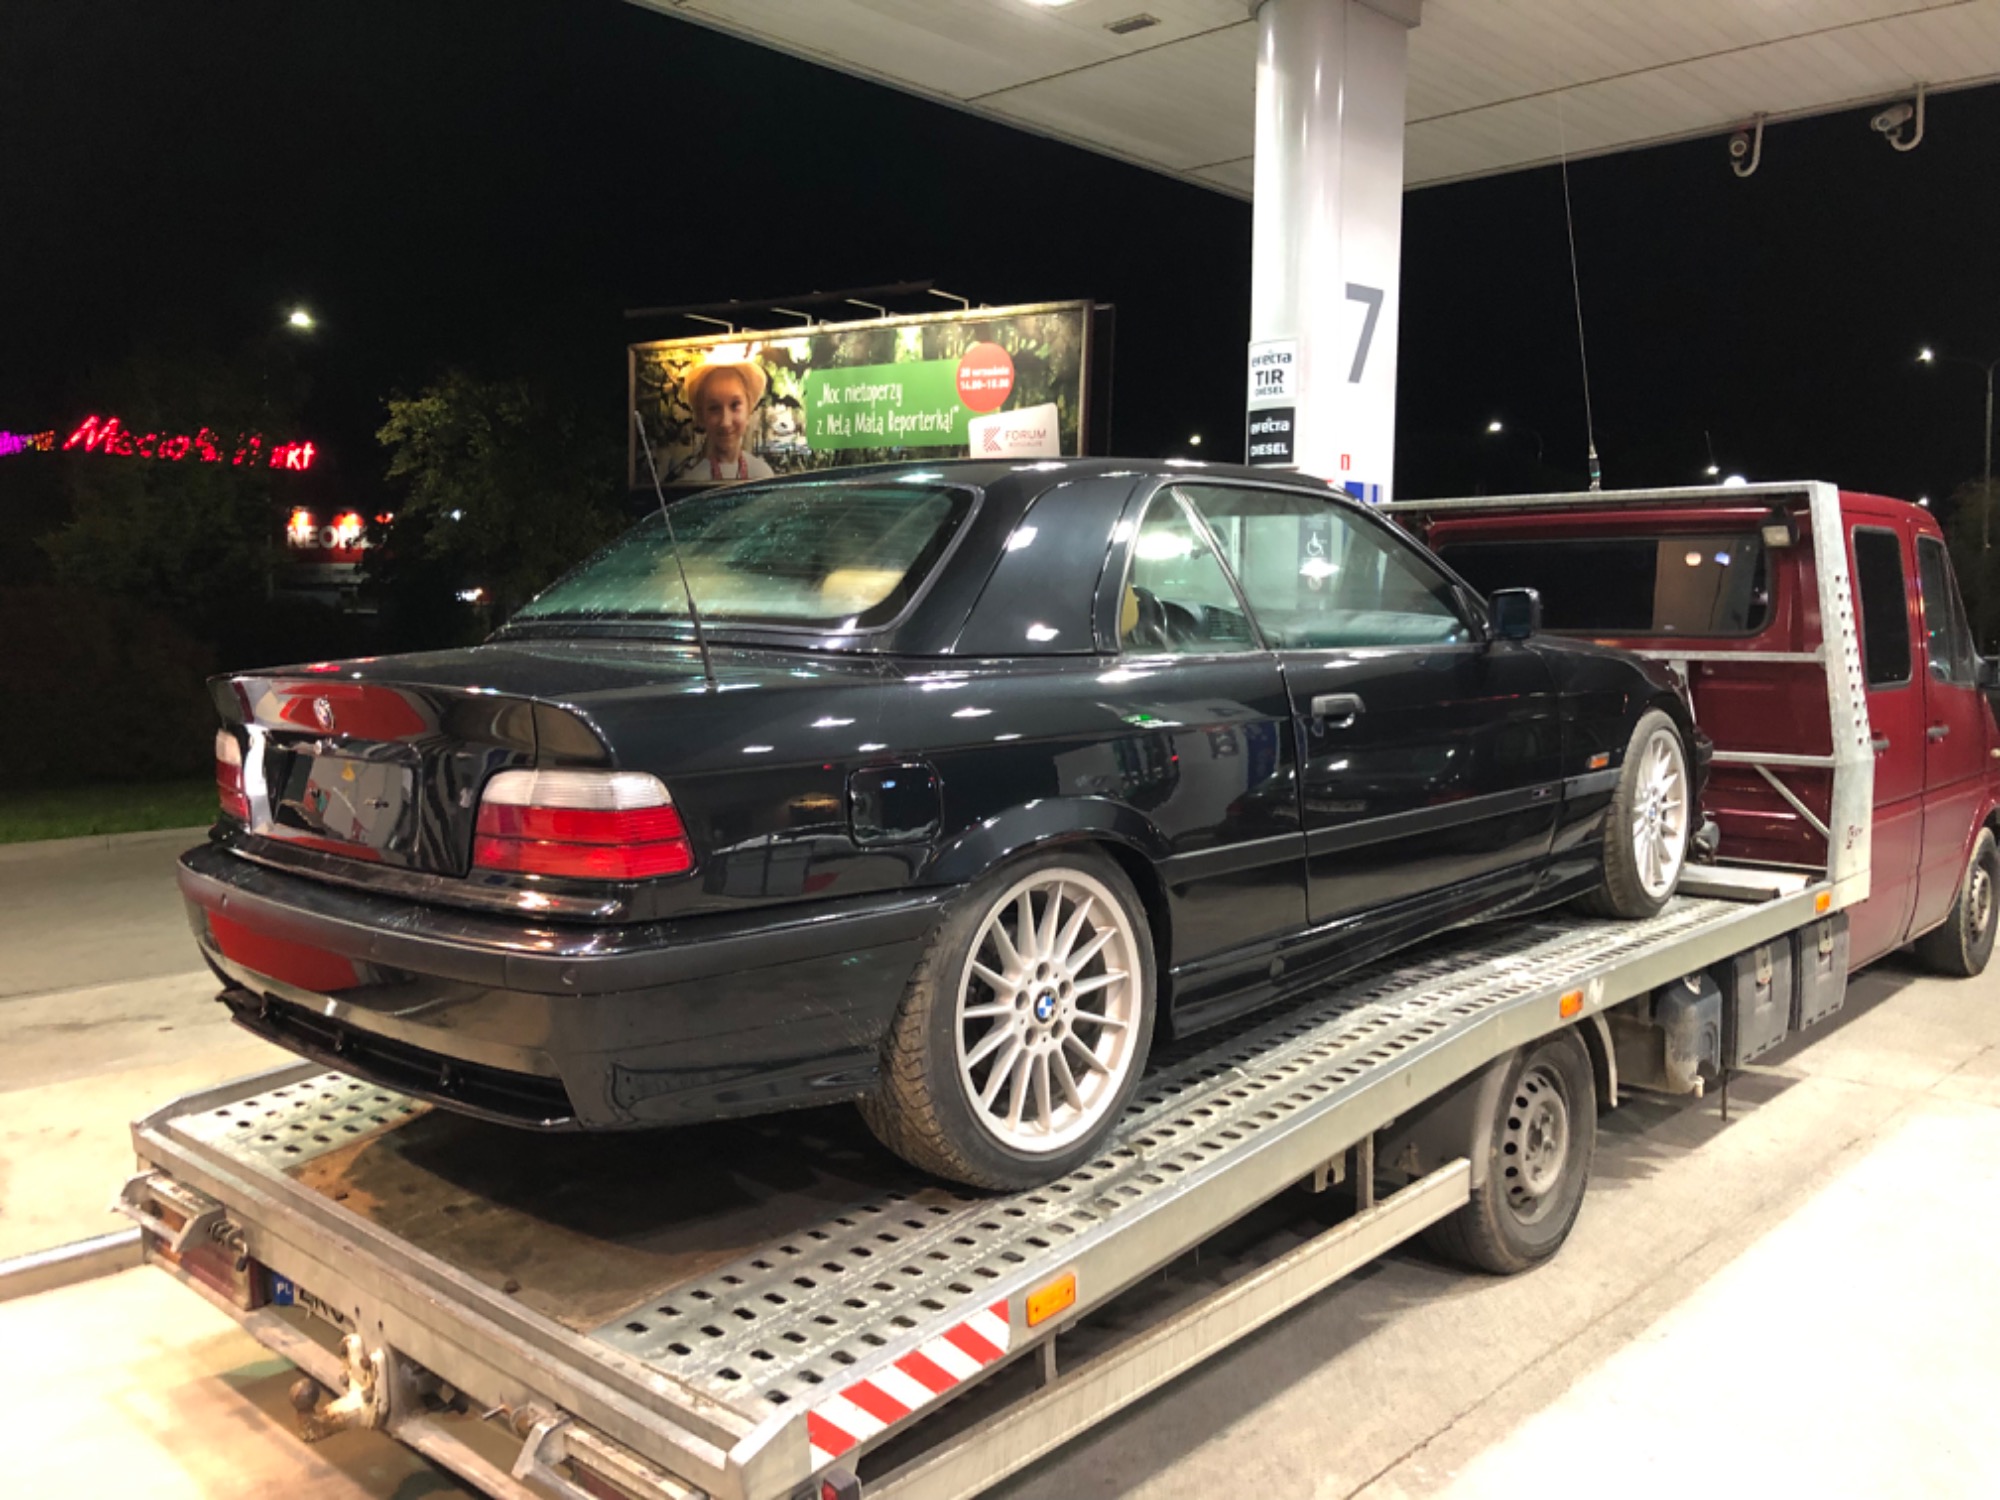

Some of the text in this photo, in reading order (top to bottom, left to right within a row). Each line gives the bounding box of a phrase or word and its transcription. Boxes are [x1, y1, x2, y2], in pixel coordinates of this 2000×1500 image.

[1345, 282, 1385, 384] 7
[1255, 369, 1284, 386] TIR
[845, 382, 903, 409] nietoperzy
[816, 420, 823, 435] z
[1005, 428, 1047, 441] FORUM
[276, 1282, 292, 1295] PL
